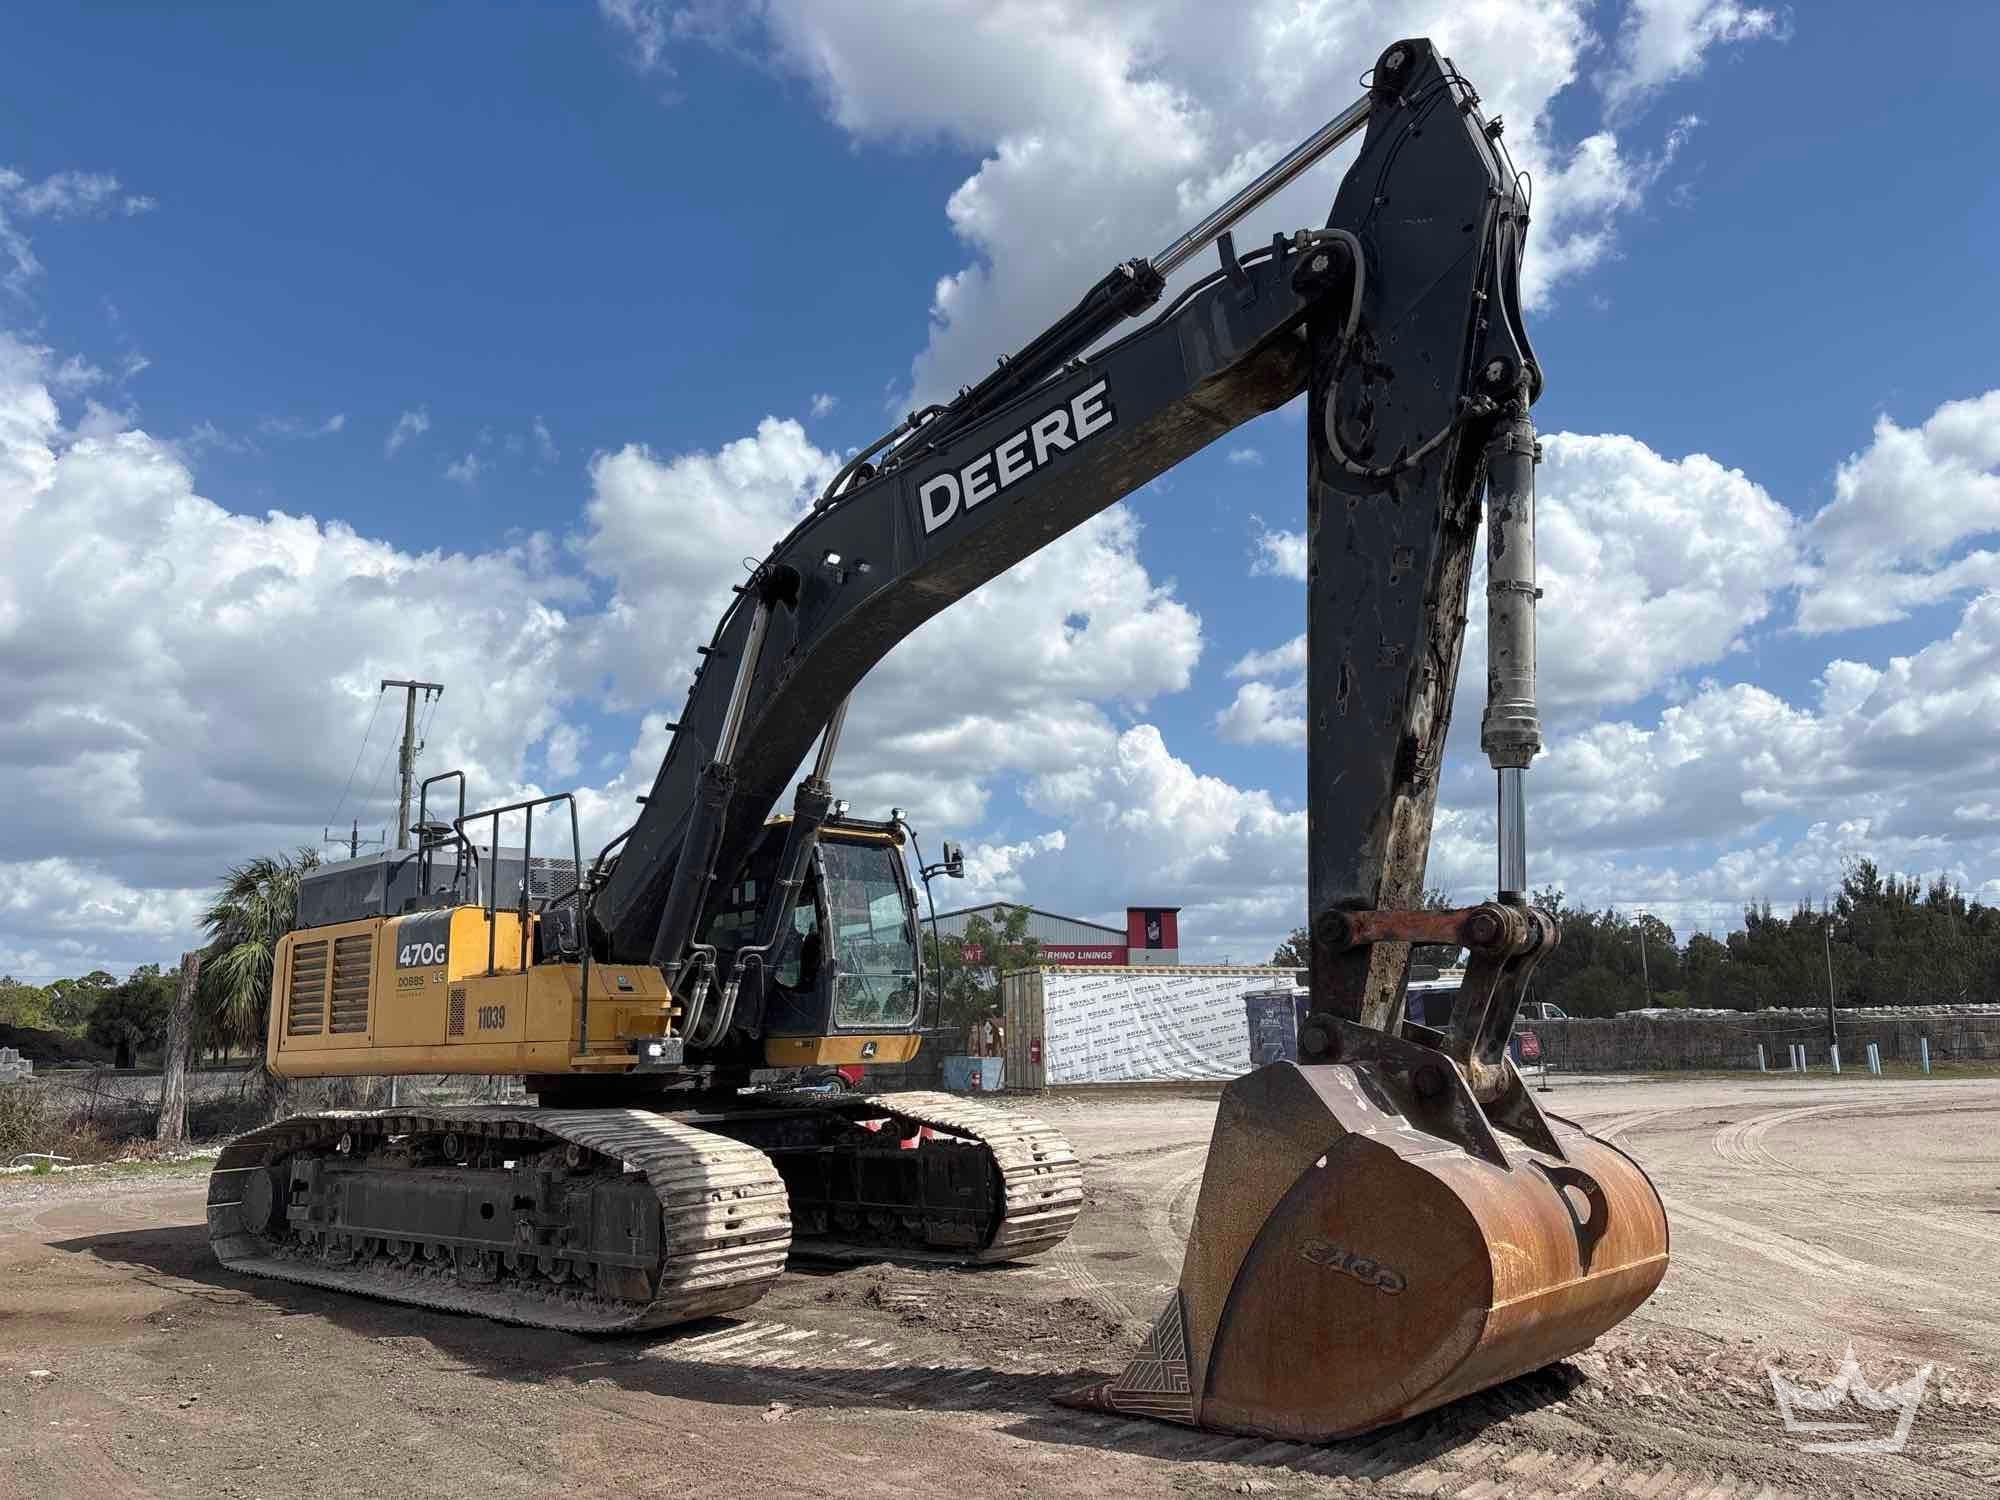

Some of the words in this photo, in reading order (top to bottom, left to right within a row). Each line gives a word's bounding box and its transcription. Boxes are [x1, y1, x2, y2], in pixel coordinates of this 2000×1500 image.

[919, 379, 1113, 534] DEERE
[399, 942, 446, 966] 470G
[1047, 951, 1075, 960] RHINO
[1077, 951, 1113, 960] LININGS
[478, 1004, 506, 1030] 11039
